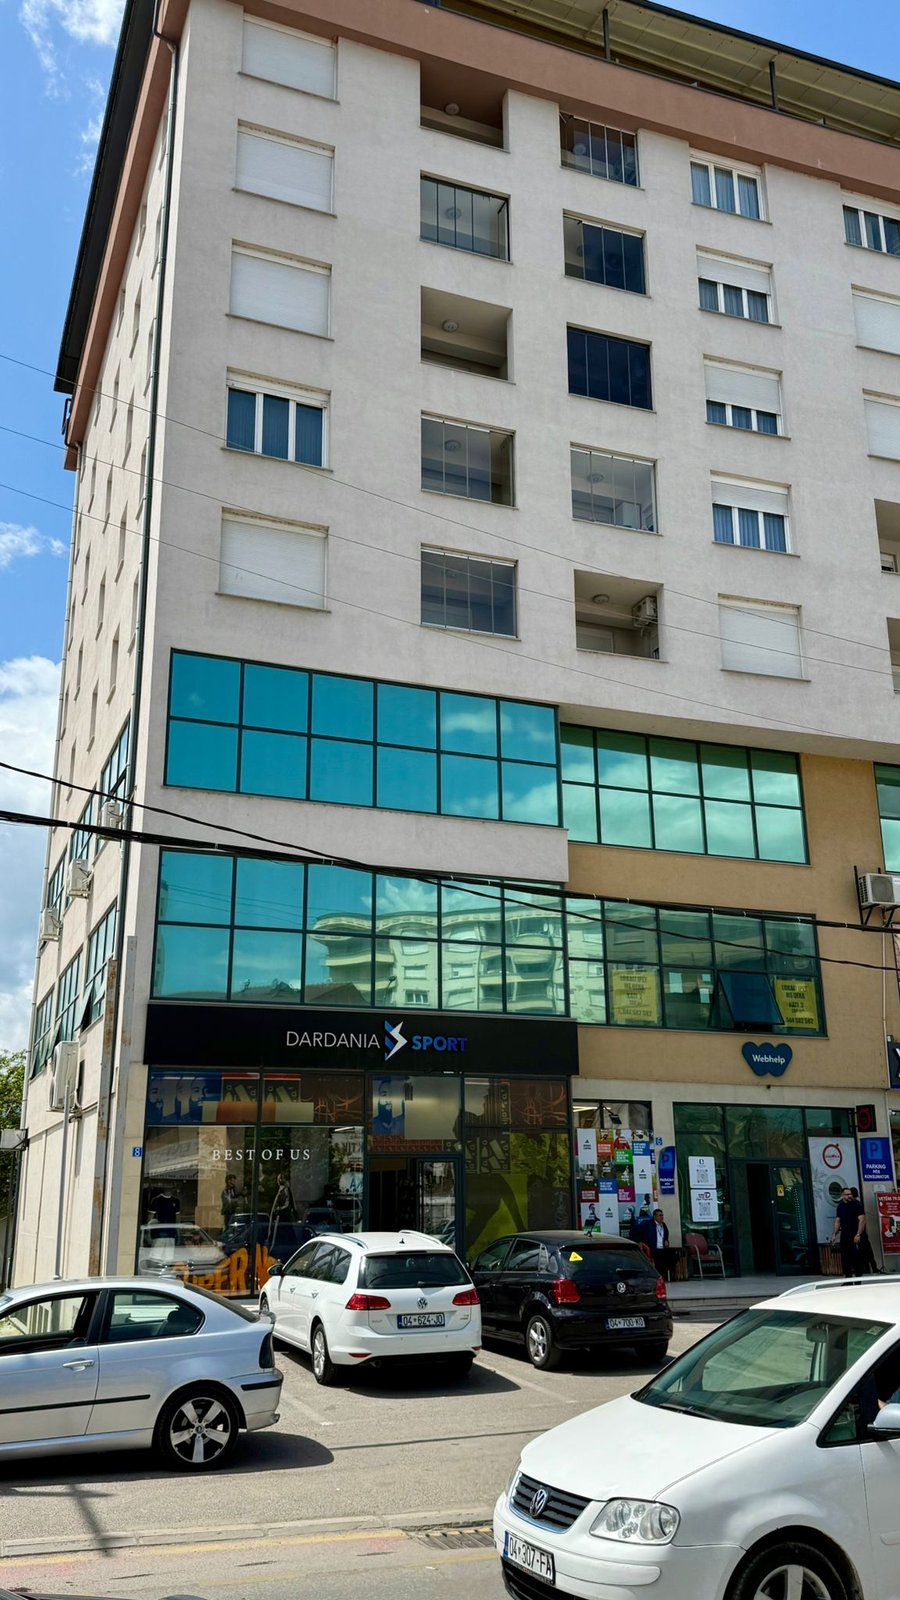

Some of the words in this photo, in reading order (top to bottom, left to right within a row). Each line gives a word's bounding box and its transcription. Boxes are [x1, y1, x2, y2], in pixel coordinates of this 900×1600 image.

[286, 1031, 380, 1048] DARDANIA
[412, 1036, 467, 1052] SPORT
[751, 1054, 786, 1065] Webhelp
[134, 1147, 141, 1157] 8
[212, 1149, 256, 1161] BEST
[261, 1149, 284, 1160] OF
[290, 1149, 310, 1160] US
[868, 1142, 879, 1158] P
